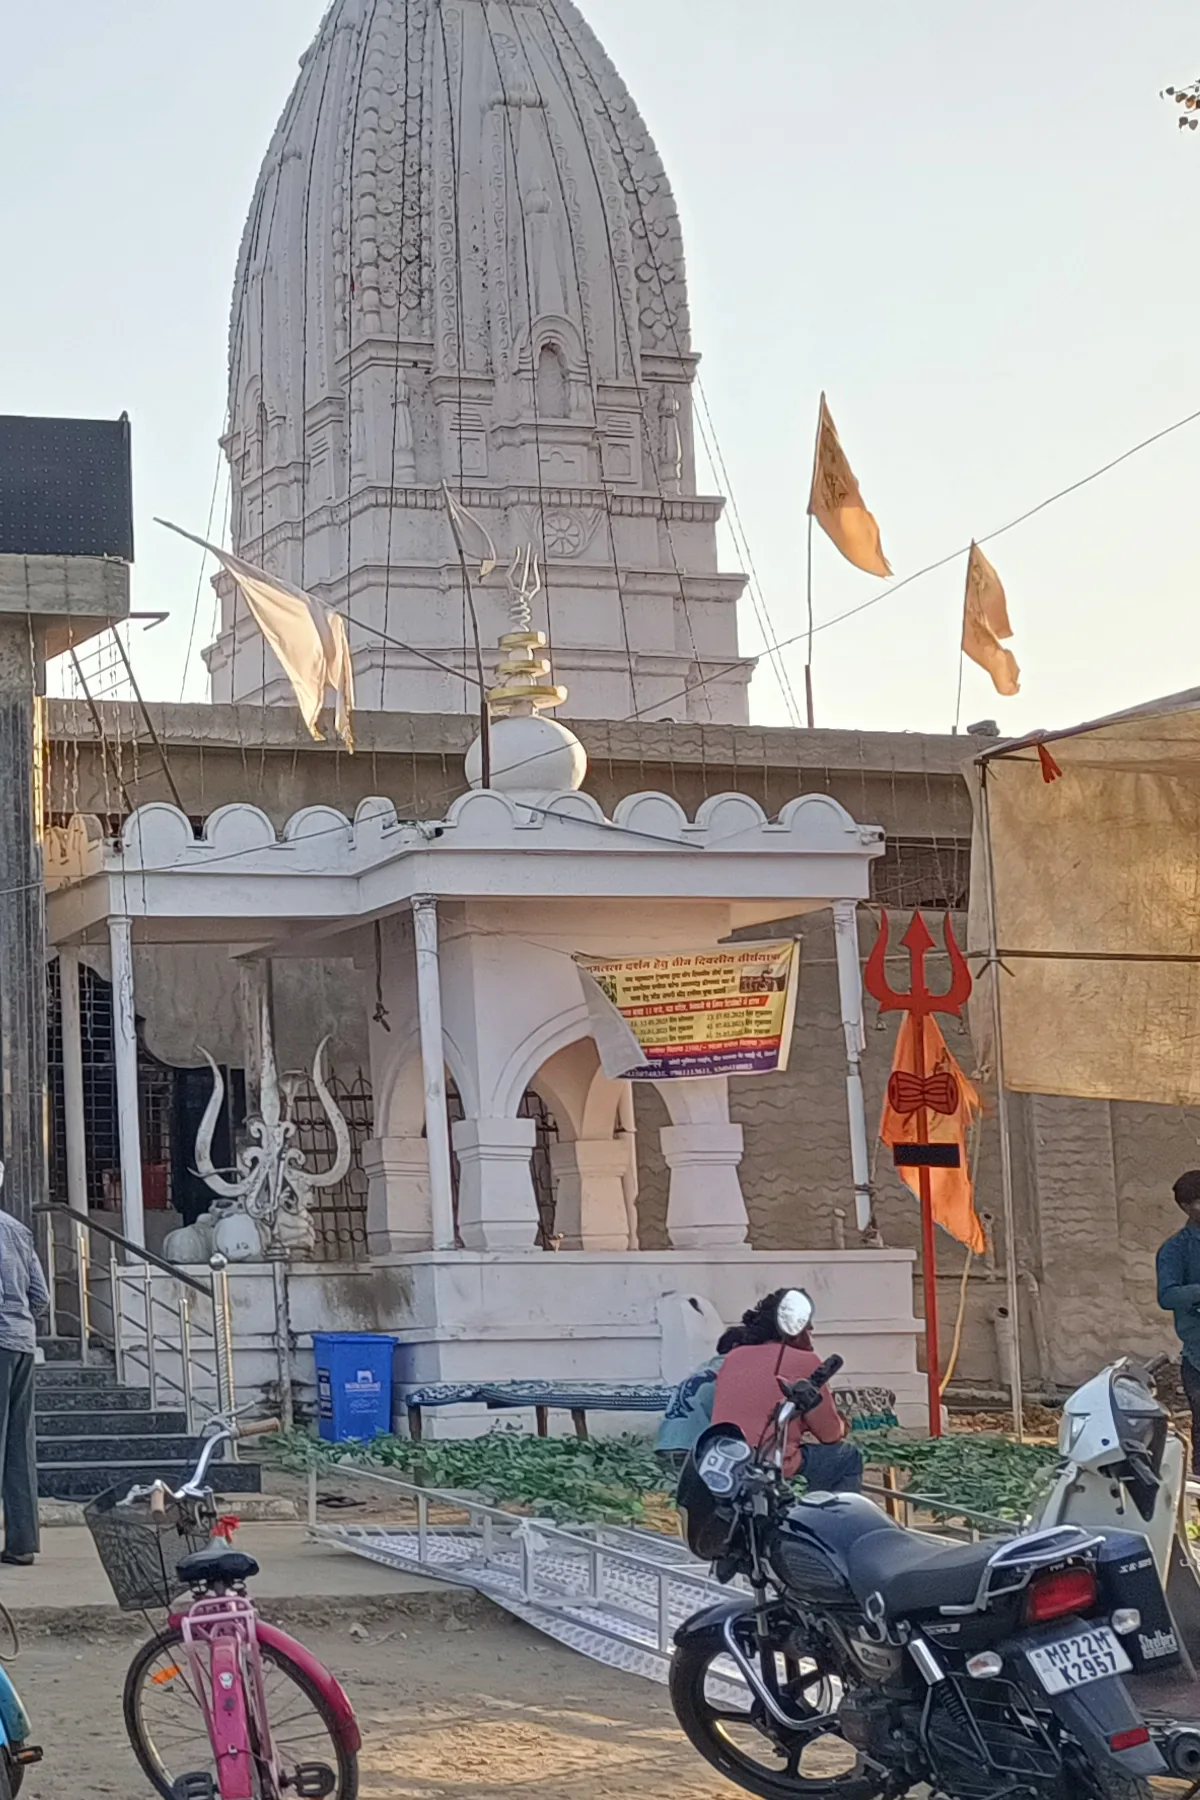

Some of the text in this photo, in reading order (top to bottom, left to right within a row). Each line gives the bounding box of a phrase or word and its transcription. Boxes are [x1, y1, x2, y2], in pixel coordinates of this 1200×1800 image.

[625, 959, 650, 971] दर्शन
[653, 957, 669, 970] हेतु
[1043, 1630, 1113, 1668] MP22M
[1058, 1650, 1117, 1686] K2957
